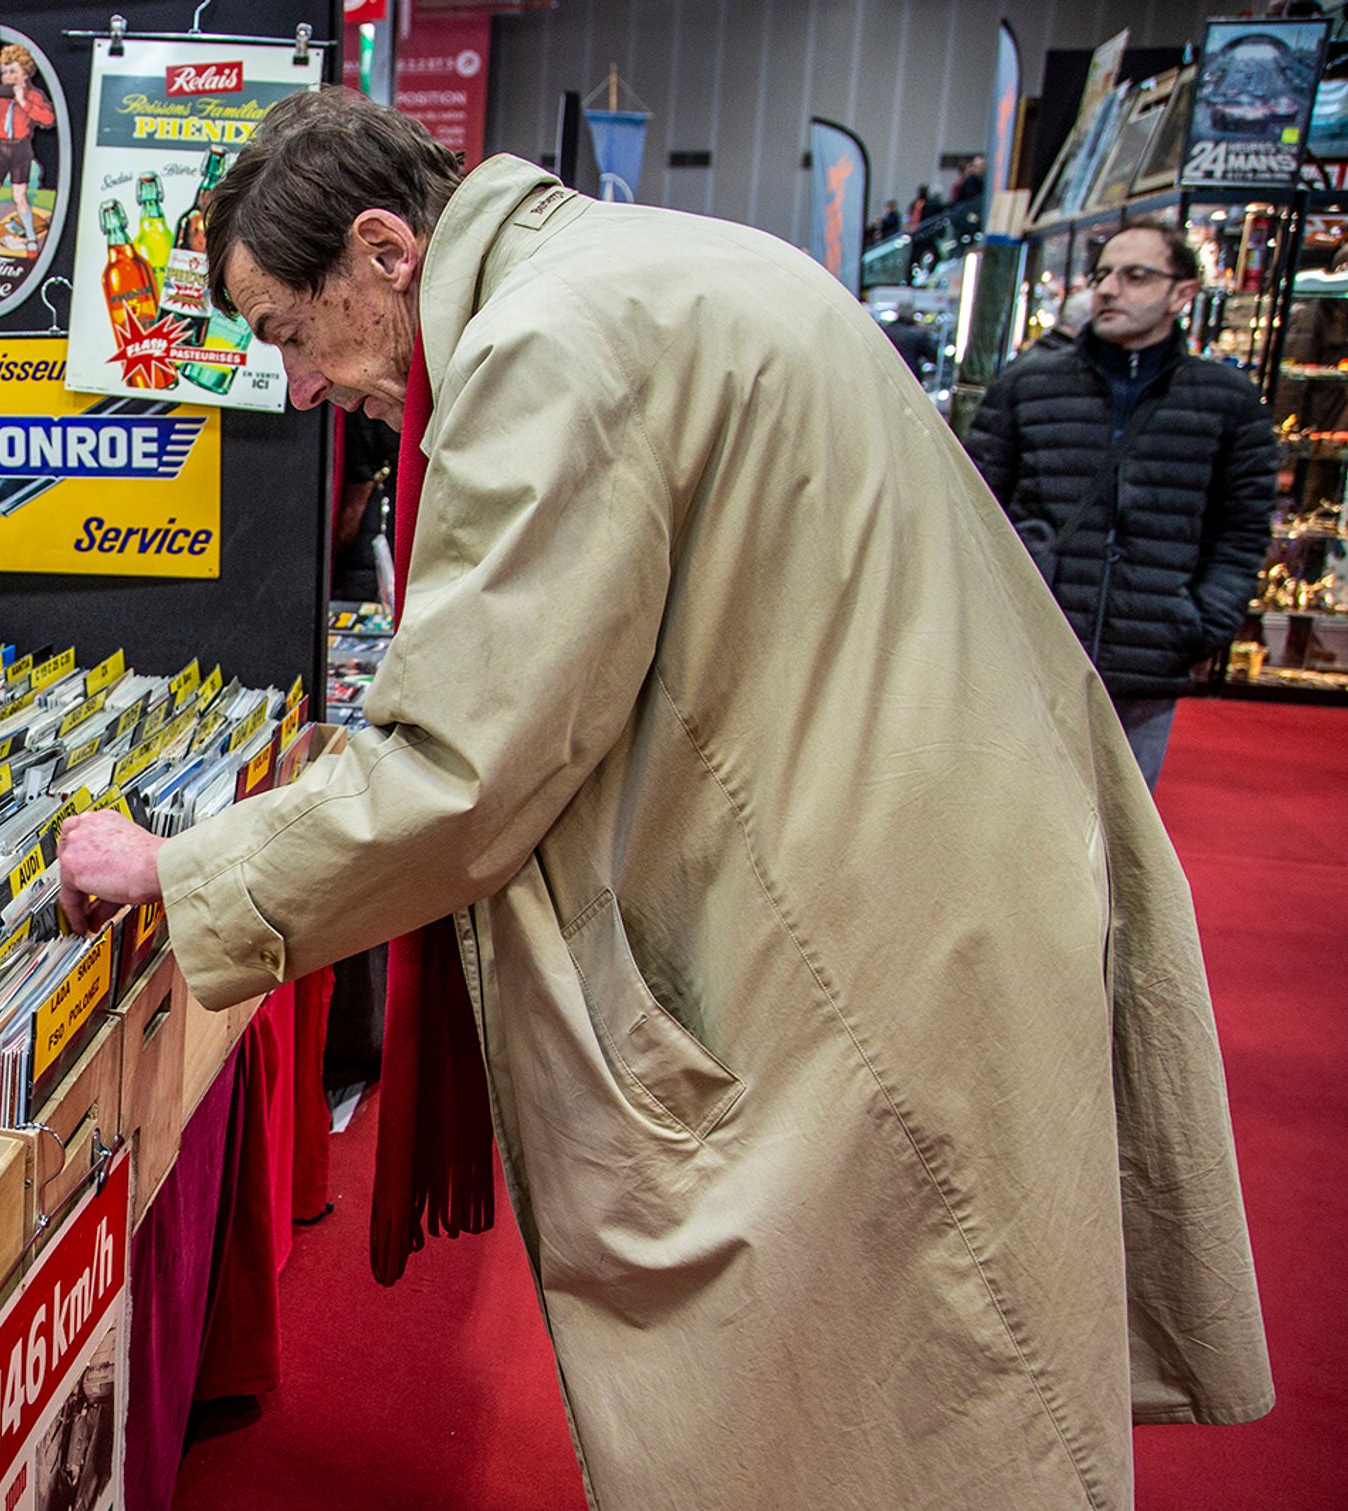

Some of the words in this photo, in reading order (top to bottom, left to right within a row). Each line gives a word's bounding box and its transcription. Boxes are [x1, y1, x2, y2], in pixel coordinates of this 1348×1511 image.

[169, 65, 239, 93] Relais
[115, 93, 192, 116] Boissons
[1182, 140, 1228, 180] 24
[1227, 154, 1298, 173] MANS
[126, 337, 169, 356] FLASH
[169, 348, 242, 363] PASTEURISÉS
[252, 379, 270, 390] ICI
[74, 516, 213, 556] Service
[50, 980, 71, 1015] LADA
[48, 1022, 65, 1052] FSO
[52, 1215, 115, 1372] km/h
